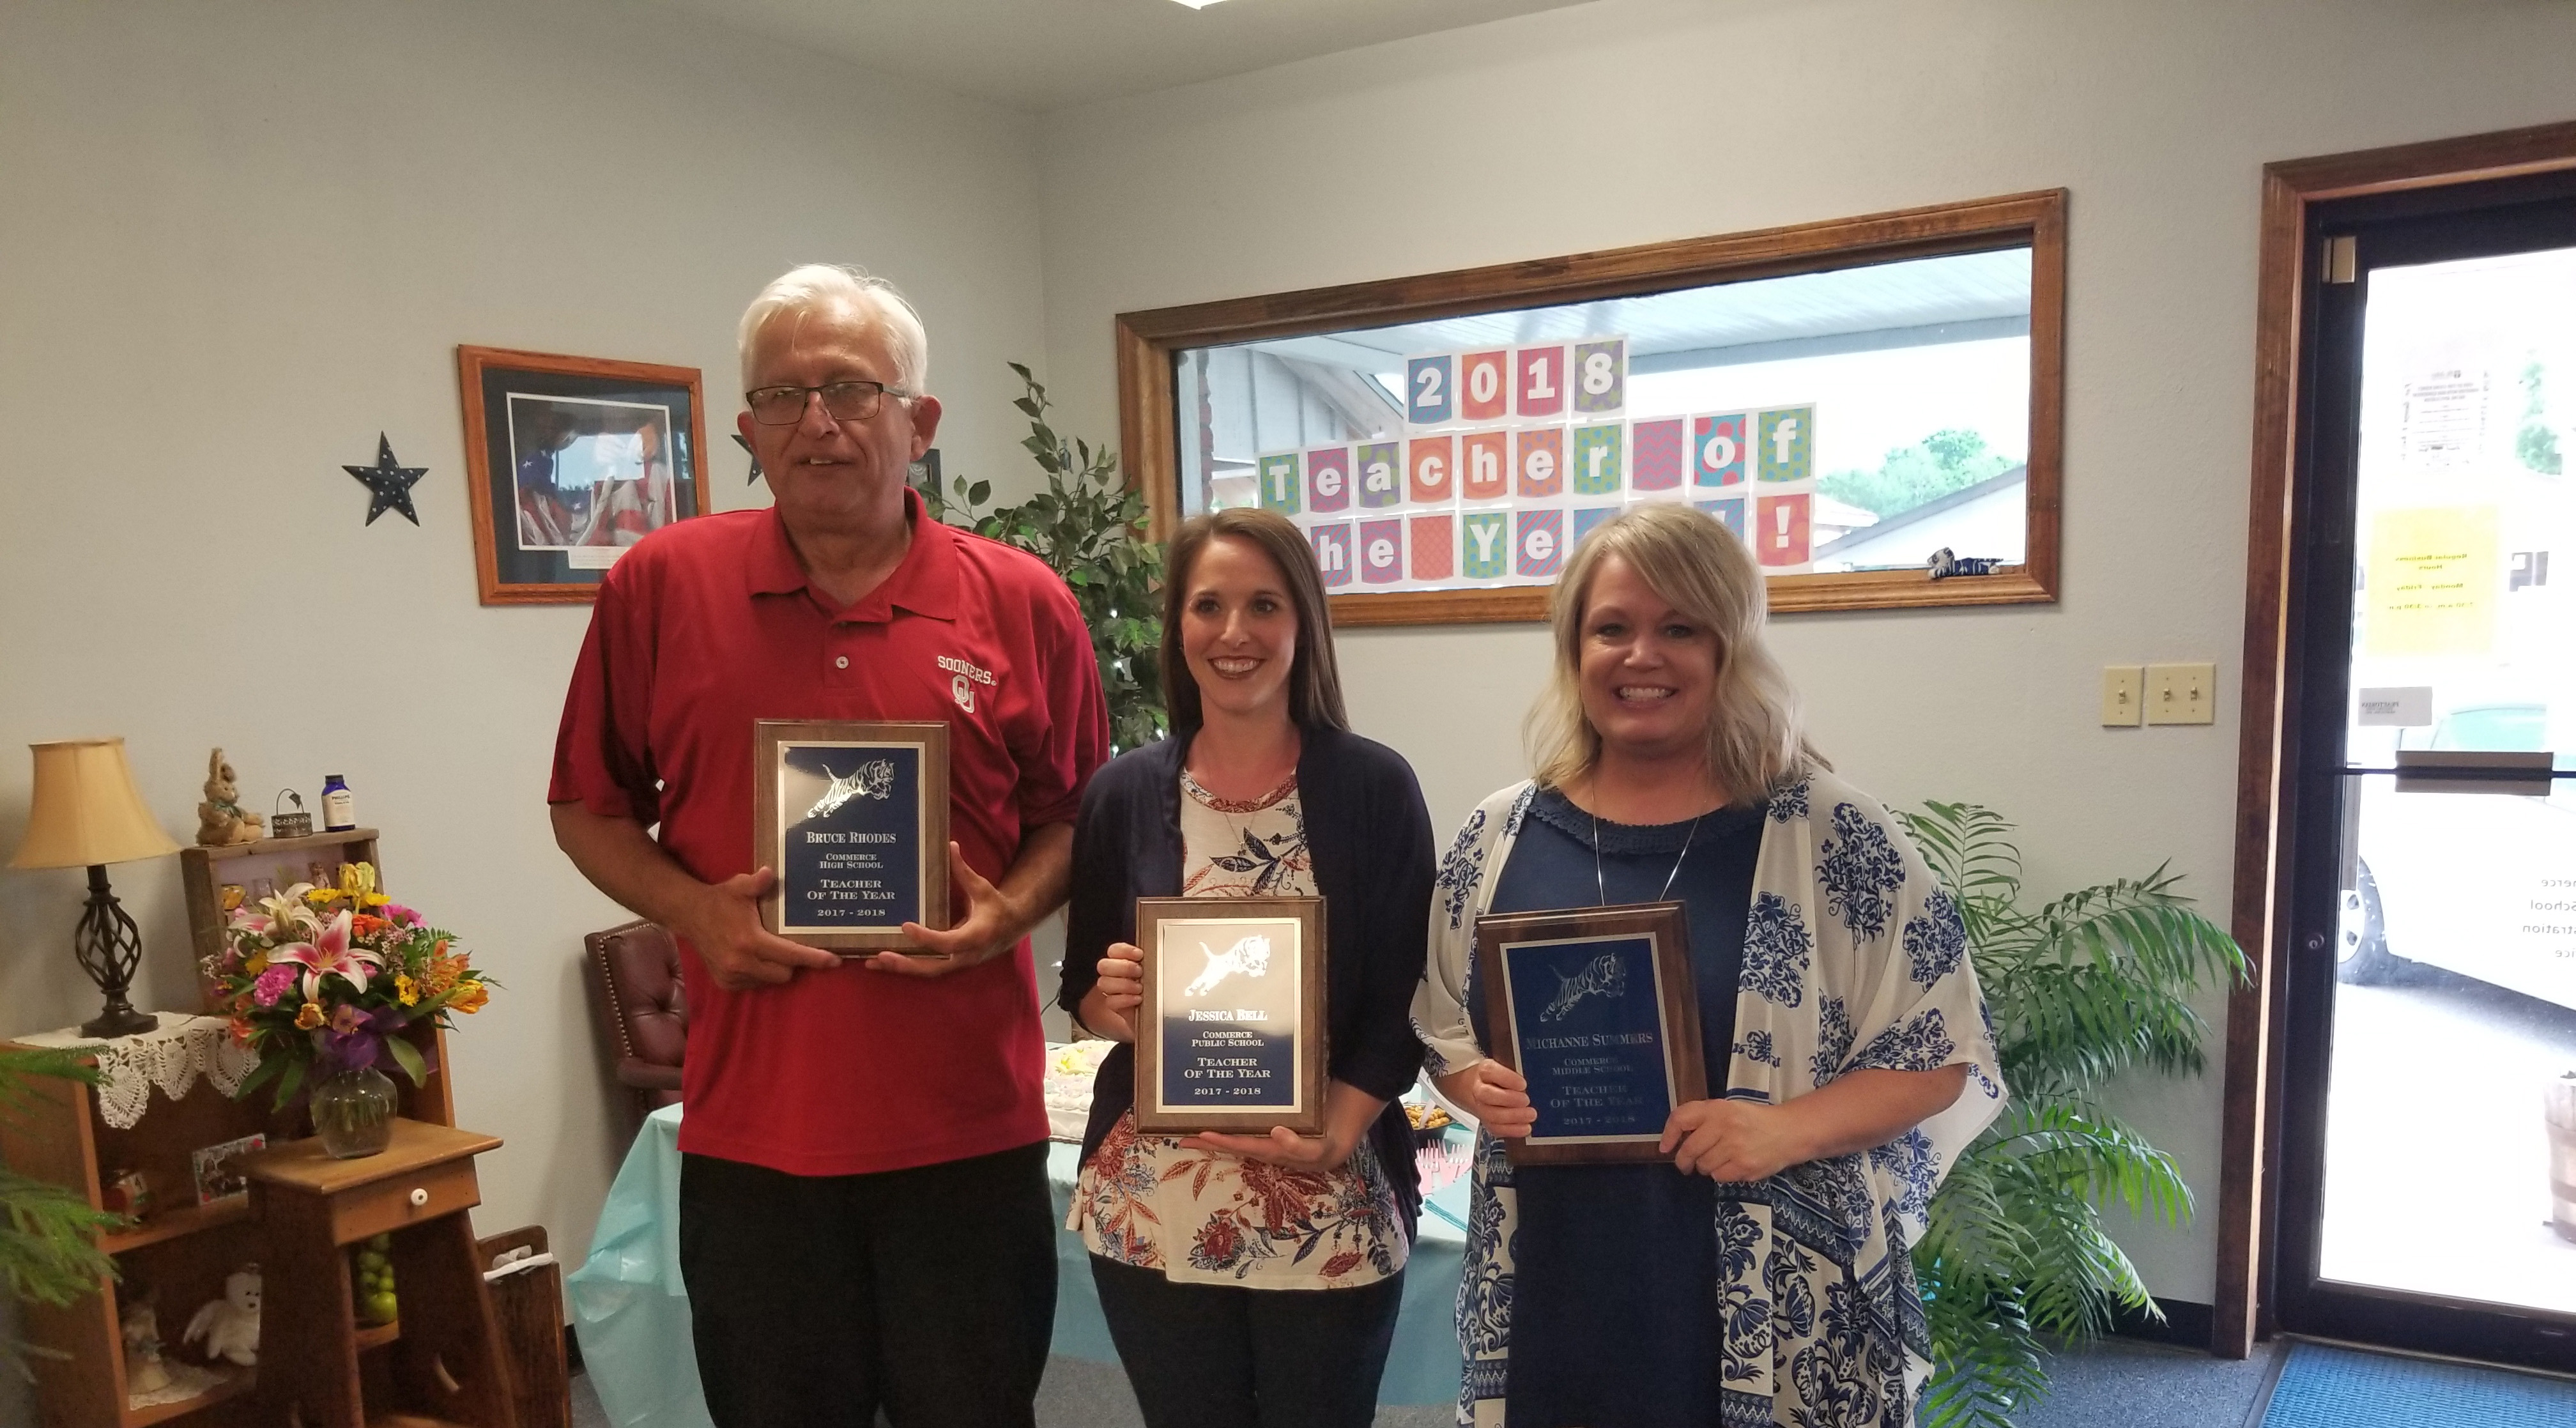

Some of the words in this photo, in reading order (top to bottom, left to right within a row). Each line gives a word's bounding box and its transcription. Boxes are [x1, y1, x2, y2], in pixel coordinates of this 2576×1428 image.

[1416, 353, 1614, 408] 2018
[1268, 443, 1609, 501] Teacher
[1703, 418, 1797, 470] of
[1320, 535, 1395, 572] he
[1469, 505, 1791, 562] Ye!
[937, 655, 992, 684] SOONERS
[806, 831, 846, 844] BRUCE
[849, 831, 896, 844] RHODES
[825, 853, 877, 861] COMMERCE
[819, 861, 844, 869] HIGH
[847, 861, 884, 869] SCHOOL
[820, 879, 882, 889] TEACHER
[807, 891, 827, 900] OF
[831, 891, 859, 900] THE
[861, 891, 896, 900] YEAR
[1188, 1009, 1234, 1022] JESSICA
[1236, 1009, 1268, 1021] BELL
[1202, 1031, 1253, 1039] COMMERCE
[1192, 1039, 1226, 1047] PUBLIC
[1197, 1057, 1258, 1066] TEACHER
[1184, 1069, 1204, 1079] OF
[1206, 1069, 1234, 1079] THE
[1237, 1068, 1271, 1078] YEAR
